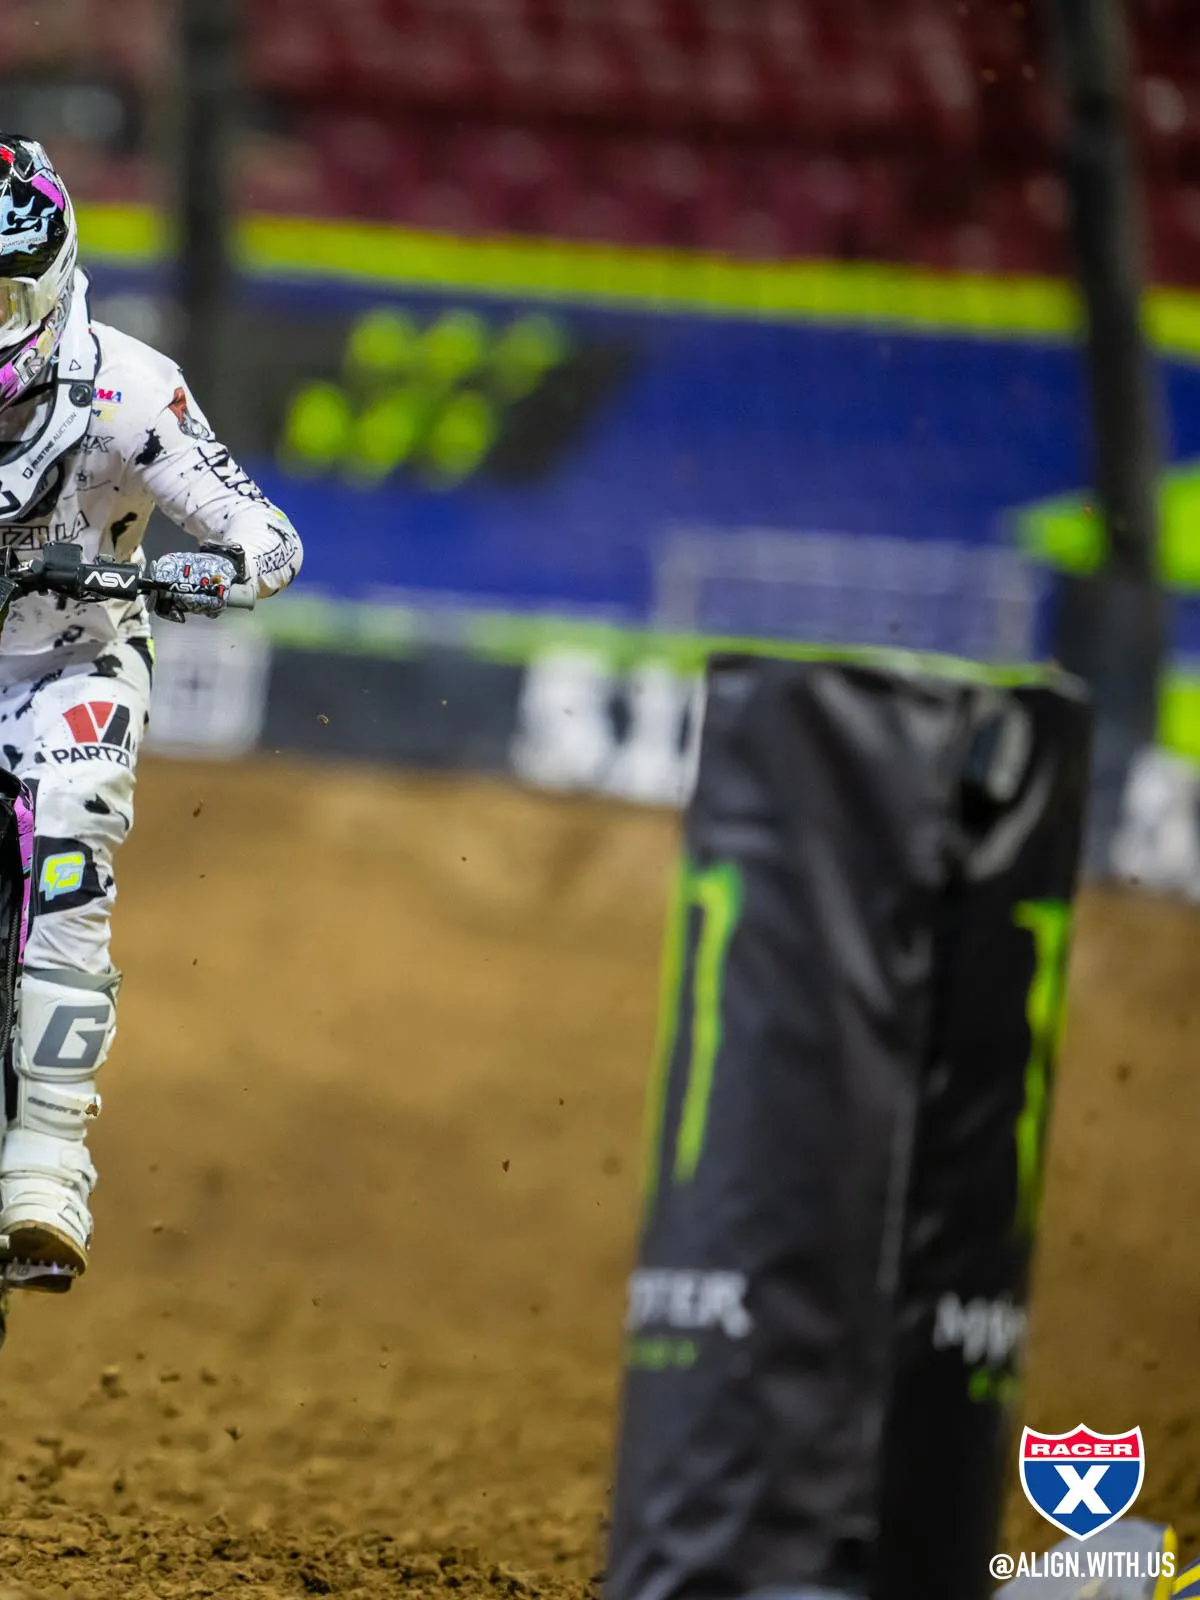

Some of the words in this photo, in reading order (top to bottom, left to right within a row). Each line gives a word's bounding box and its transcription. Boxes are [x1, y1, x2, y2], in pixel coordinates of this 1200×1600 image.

[52, 412, 78, 442] AUCTION
[84, 571, 136, 589] ASV
[169, 582, 201, 593] ASV
